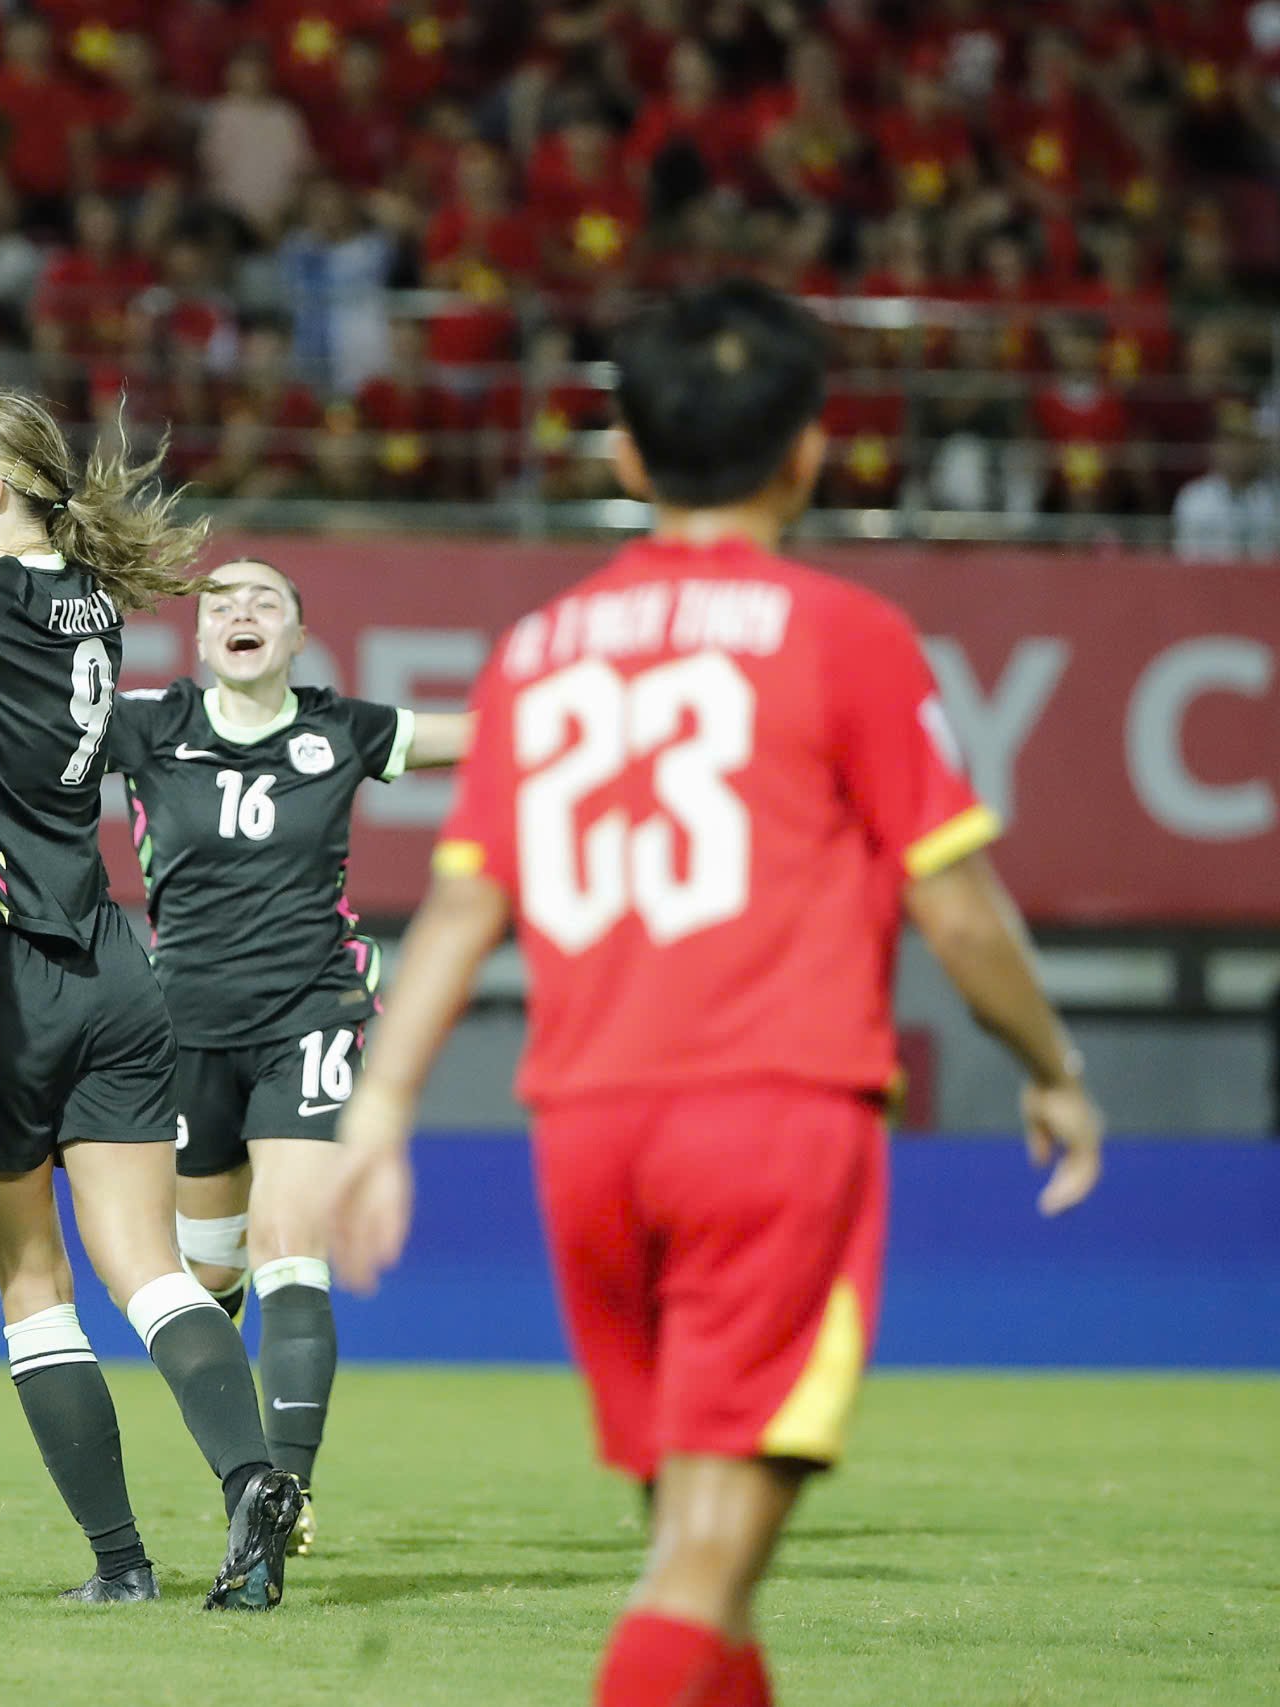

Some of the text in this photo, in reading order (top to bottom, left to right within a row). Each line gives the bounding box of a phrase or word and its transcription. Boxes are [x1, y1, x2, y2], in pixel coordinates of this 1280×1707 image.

[60, 637, 115, 785] 9
[216, 769, 276, 841] 16
[514, 652, 756, 957] 23
[299, 1029, 354, 1102] 16
